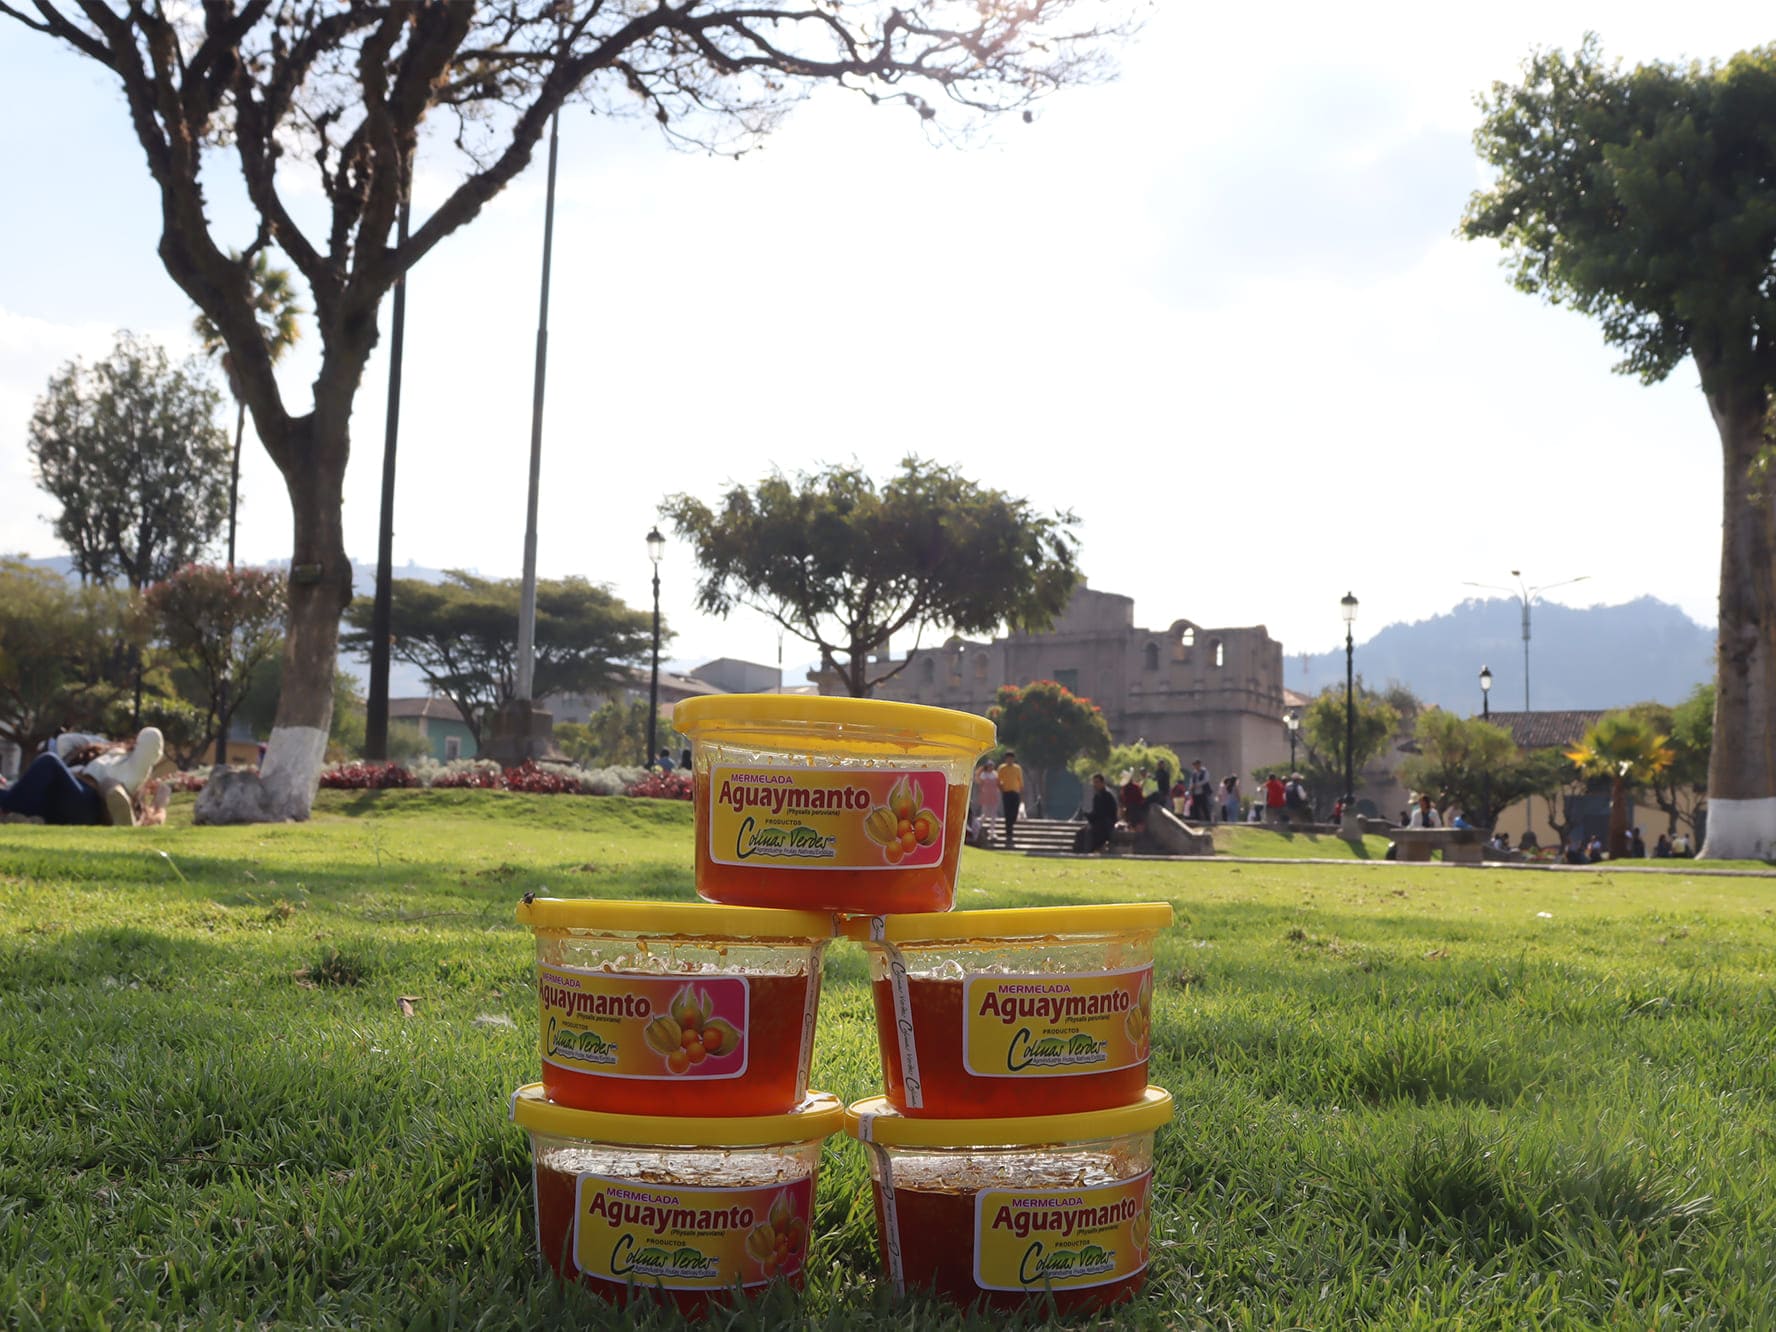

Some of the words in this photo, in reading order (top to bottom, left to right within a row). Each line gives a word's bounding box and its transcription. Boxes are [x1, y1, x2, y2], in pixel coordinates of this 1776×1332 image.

[731, 774, 793, 784] MERMELADA
[719, 781, 870, 814] Aguaymanto
[737, 816, 785, 858] Colinas
[789, 829, 828, 849] Verdes
[543, 973, 581, 988] MERMELADA
[999, 984, 1070, 994] MERMELADA
[979, 990, 1130, 1024] Aguaymanto
[579, 1034, 612, 1055] Verdes
[1007, 1027, 1064, 1071] Colinas
[1069, 1036, 1101, 1055] Verdes
[607, 1187, 679, 1205] MERMELADA
[1012, 1198, 1083, 1208] MERMELADA
[589, 1193, 753, 1234] Aguaymanto
[992, 1199, 1136, 1238] Aguaymanto
[646, 1238, 686, 1246] PRODUCTOS
[610, 1233, 668, 1275] Colinas
[672, 1250, 712, 1270] Verdes
[1079, 1247, 1110, 1267] Verdes
